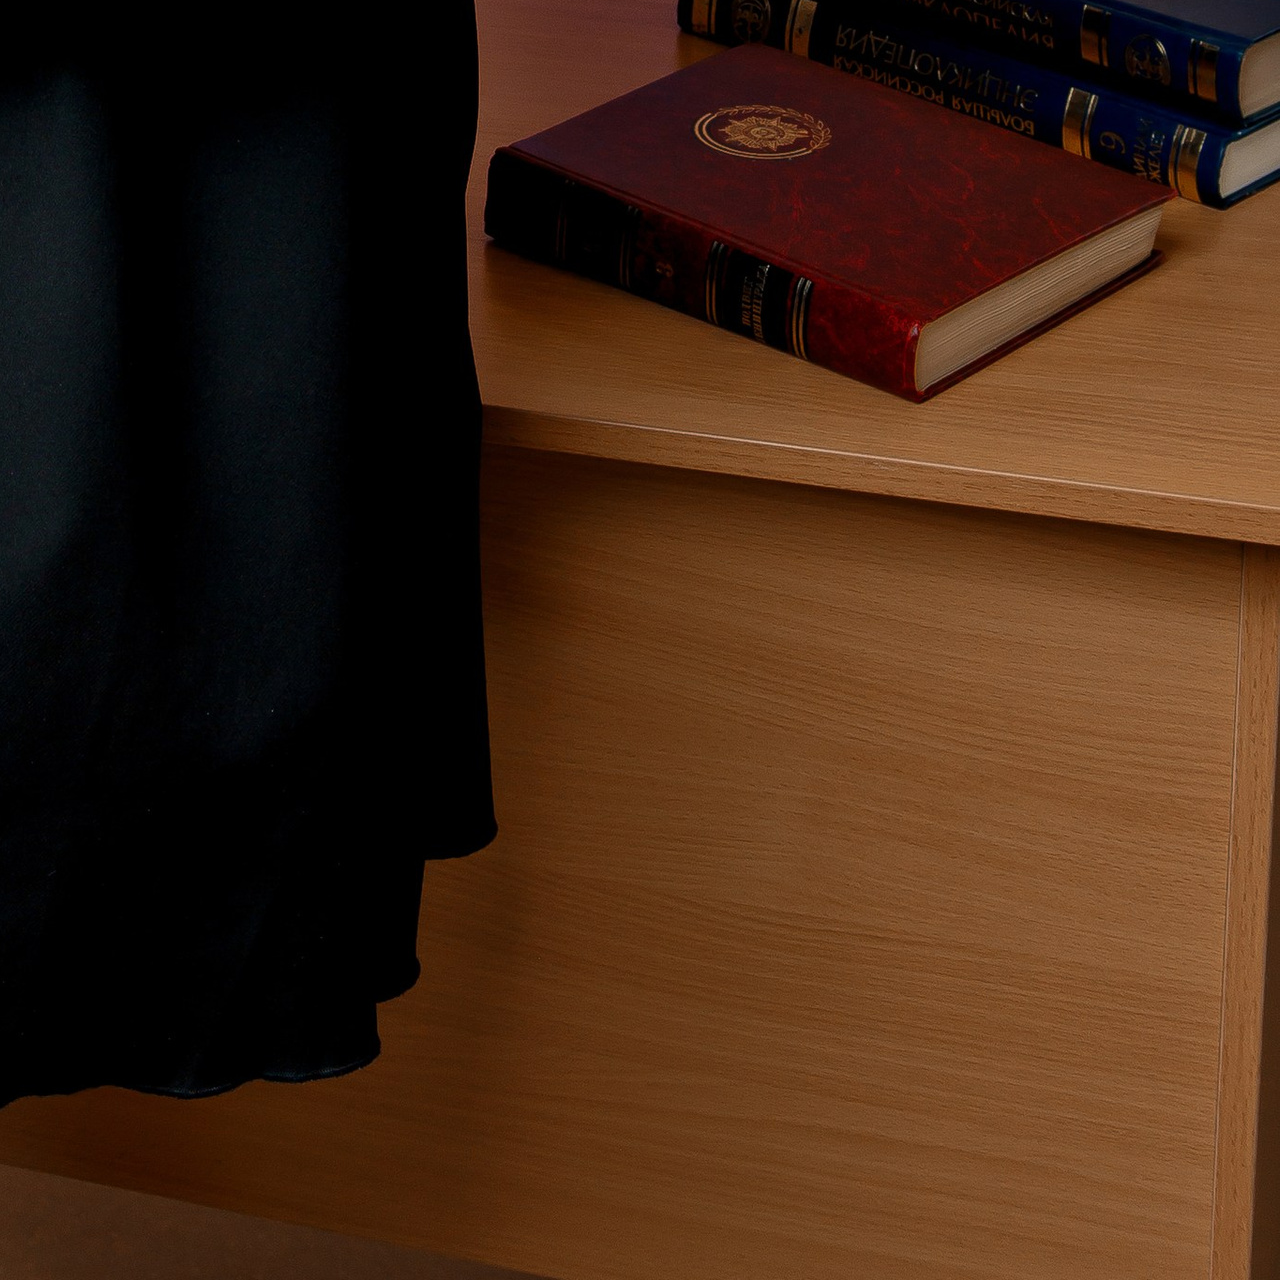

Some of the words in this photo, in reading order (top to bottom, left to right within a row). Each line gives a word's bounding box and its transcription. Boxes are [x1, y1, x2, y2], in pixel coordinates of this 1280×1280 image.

[835, 23, 1039, 112] ЭНЦИКЛОПЕДИЯ
[951, 95, 1035, 137] БОЛЬШАЯ
[1099, 130, 1126, 155] 9
